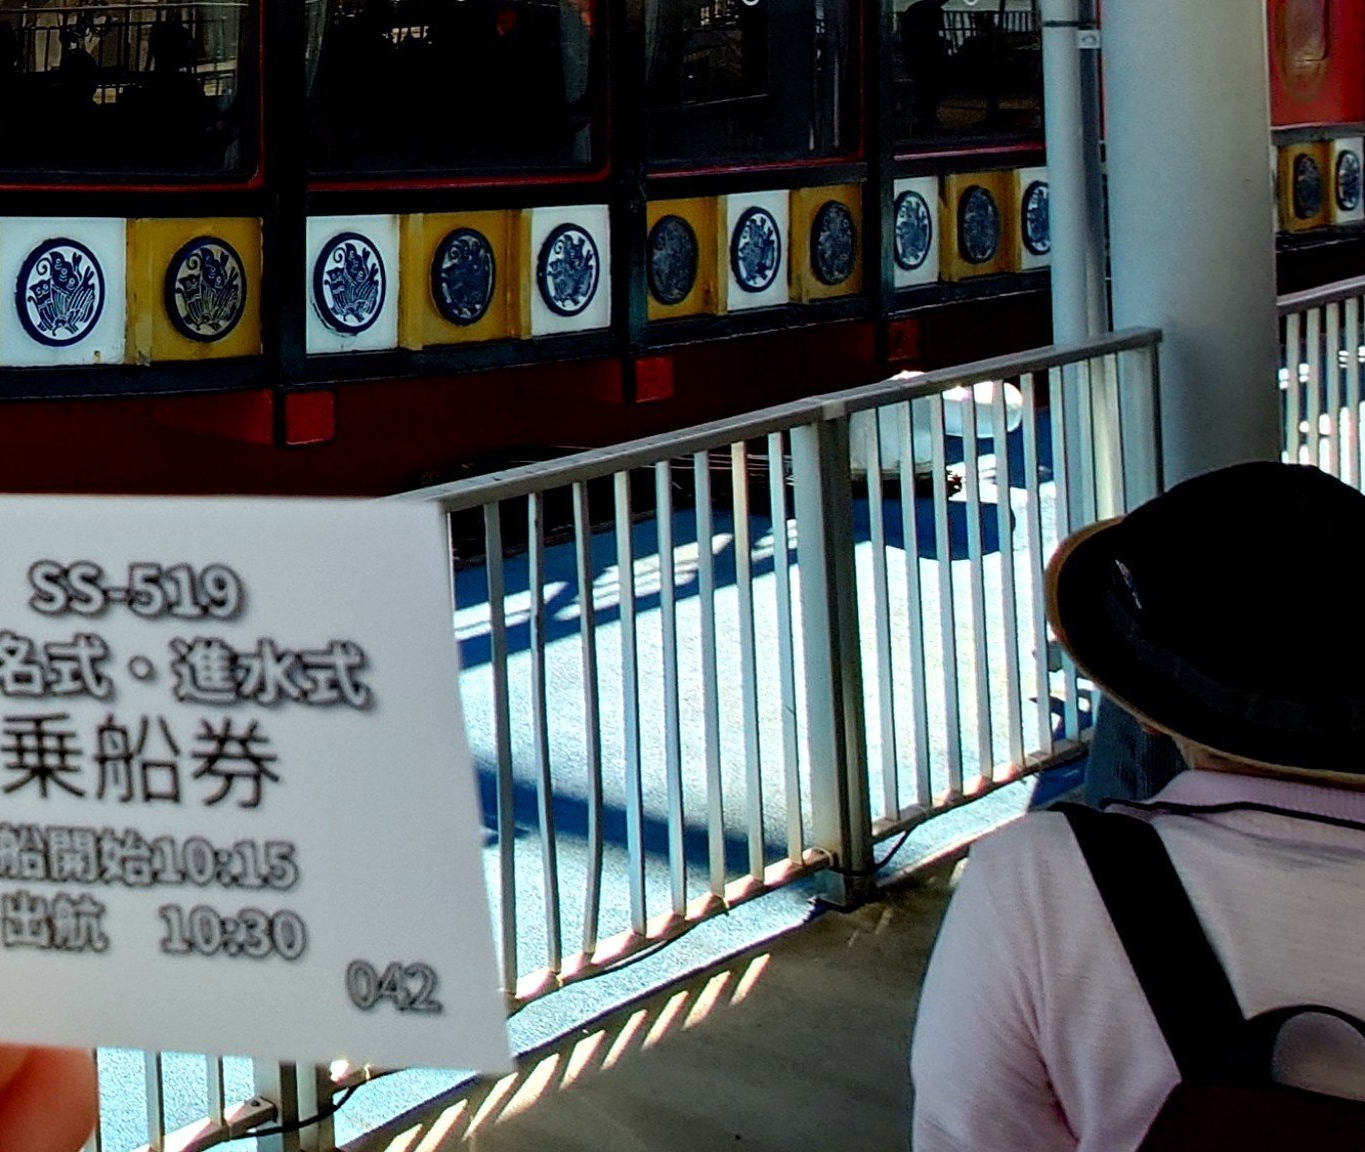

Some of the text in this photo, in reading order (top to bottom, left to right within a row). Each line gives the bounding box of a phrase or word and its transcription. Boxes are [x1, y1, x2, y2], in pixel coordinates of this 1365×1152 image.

[27, 559, 245, 621] SS-519
[0, 712, 280, 808] 乗船券
[0, 890, 308, 960] 出航 10:30
[345, 958, 444, 1015] 042
